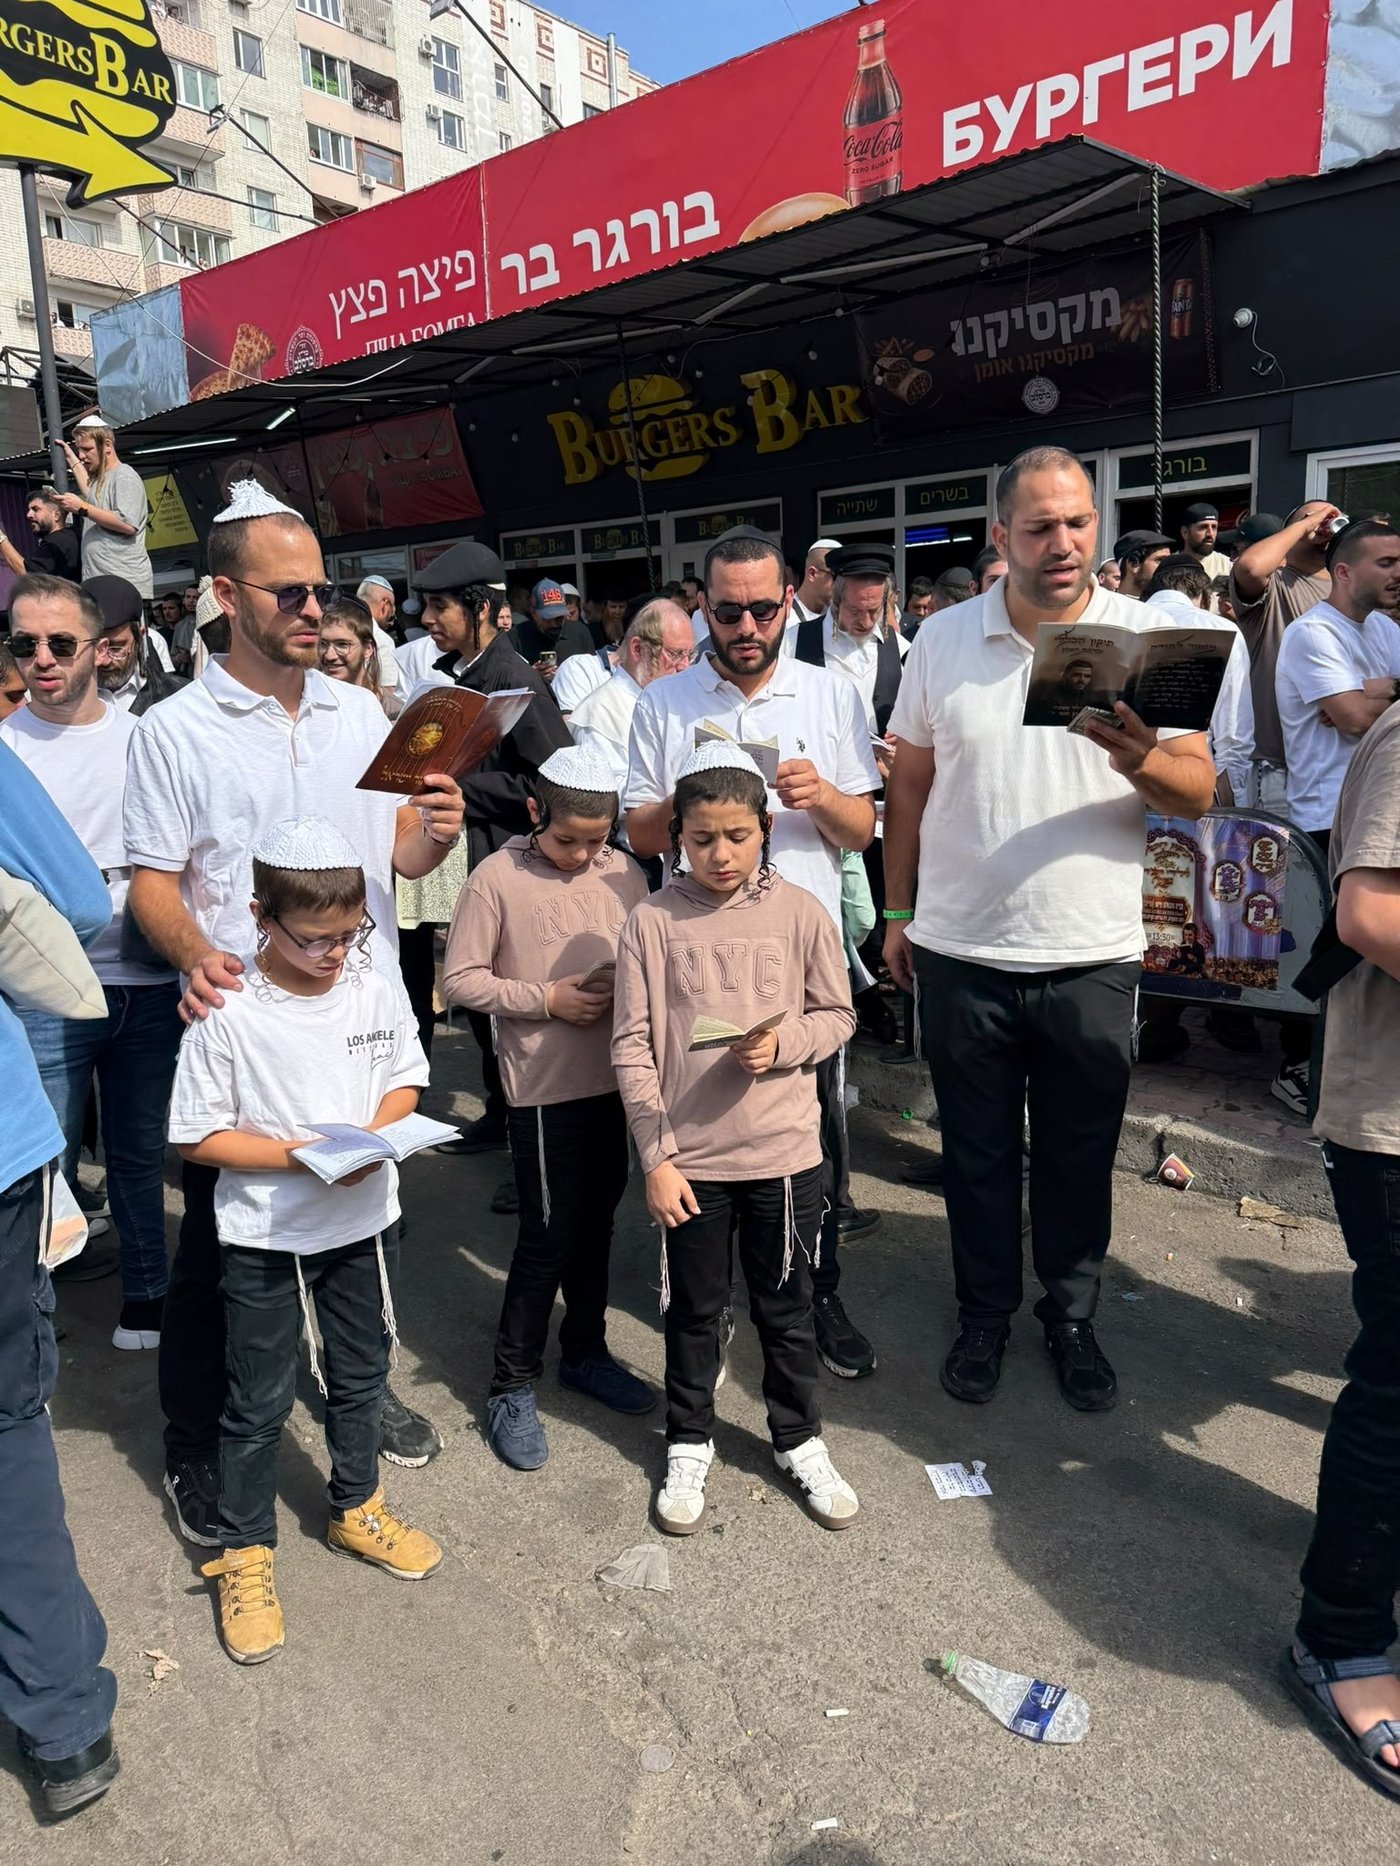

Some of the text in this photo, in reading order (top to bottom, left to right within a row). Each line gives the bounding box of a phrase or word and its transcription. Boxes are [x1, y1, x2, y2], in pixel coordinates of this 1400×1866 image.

[90, 32, 174, 104] BAR
[942, 0, 1294, 168] БУРГЕРИ
[852, 156, 894, 174] ZERO SUGAR
[500, 191, 720, 295] בורגר בר
[329, 250, 476, 339] פיצה פצץ
[950, 287, 1122, 360] מקסיקנו
[974, 341, 1095, 383] מקסיקנו אומן
[547, 368, 868, 485] BURGERS BAR
[837, 498, 878, 517] שתייה
[920, 487, 969, 506] בשרים
[535, 891, 628, 945] NYC
[1152, 932, 1171, 941] 13:30
[671, 944, 782, 999] NYC
[347, 1035, 365, 1047] LOS
